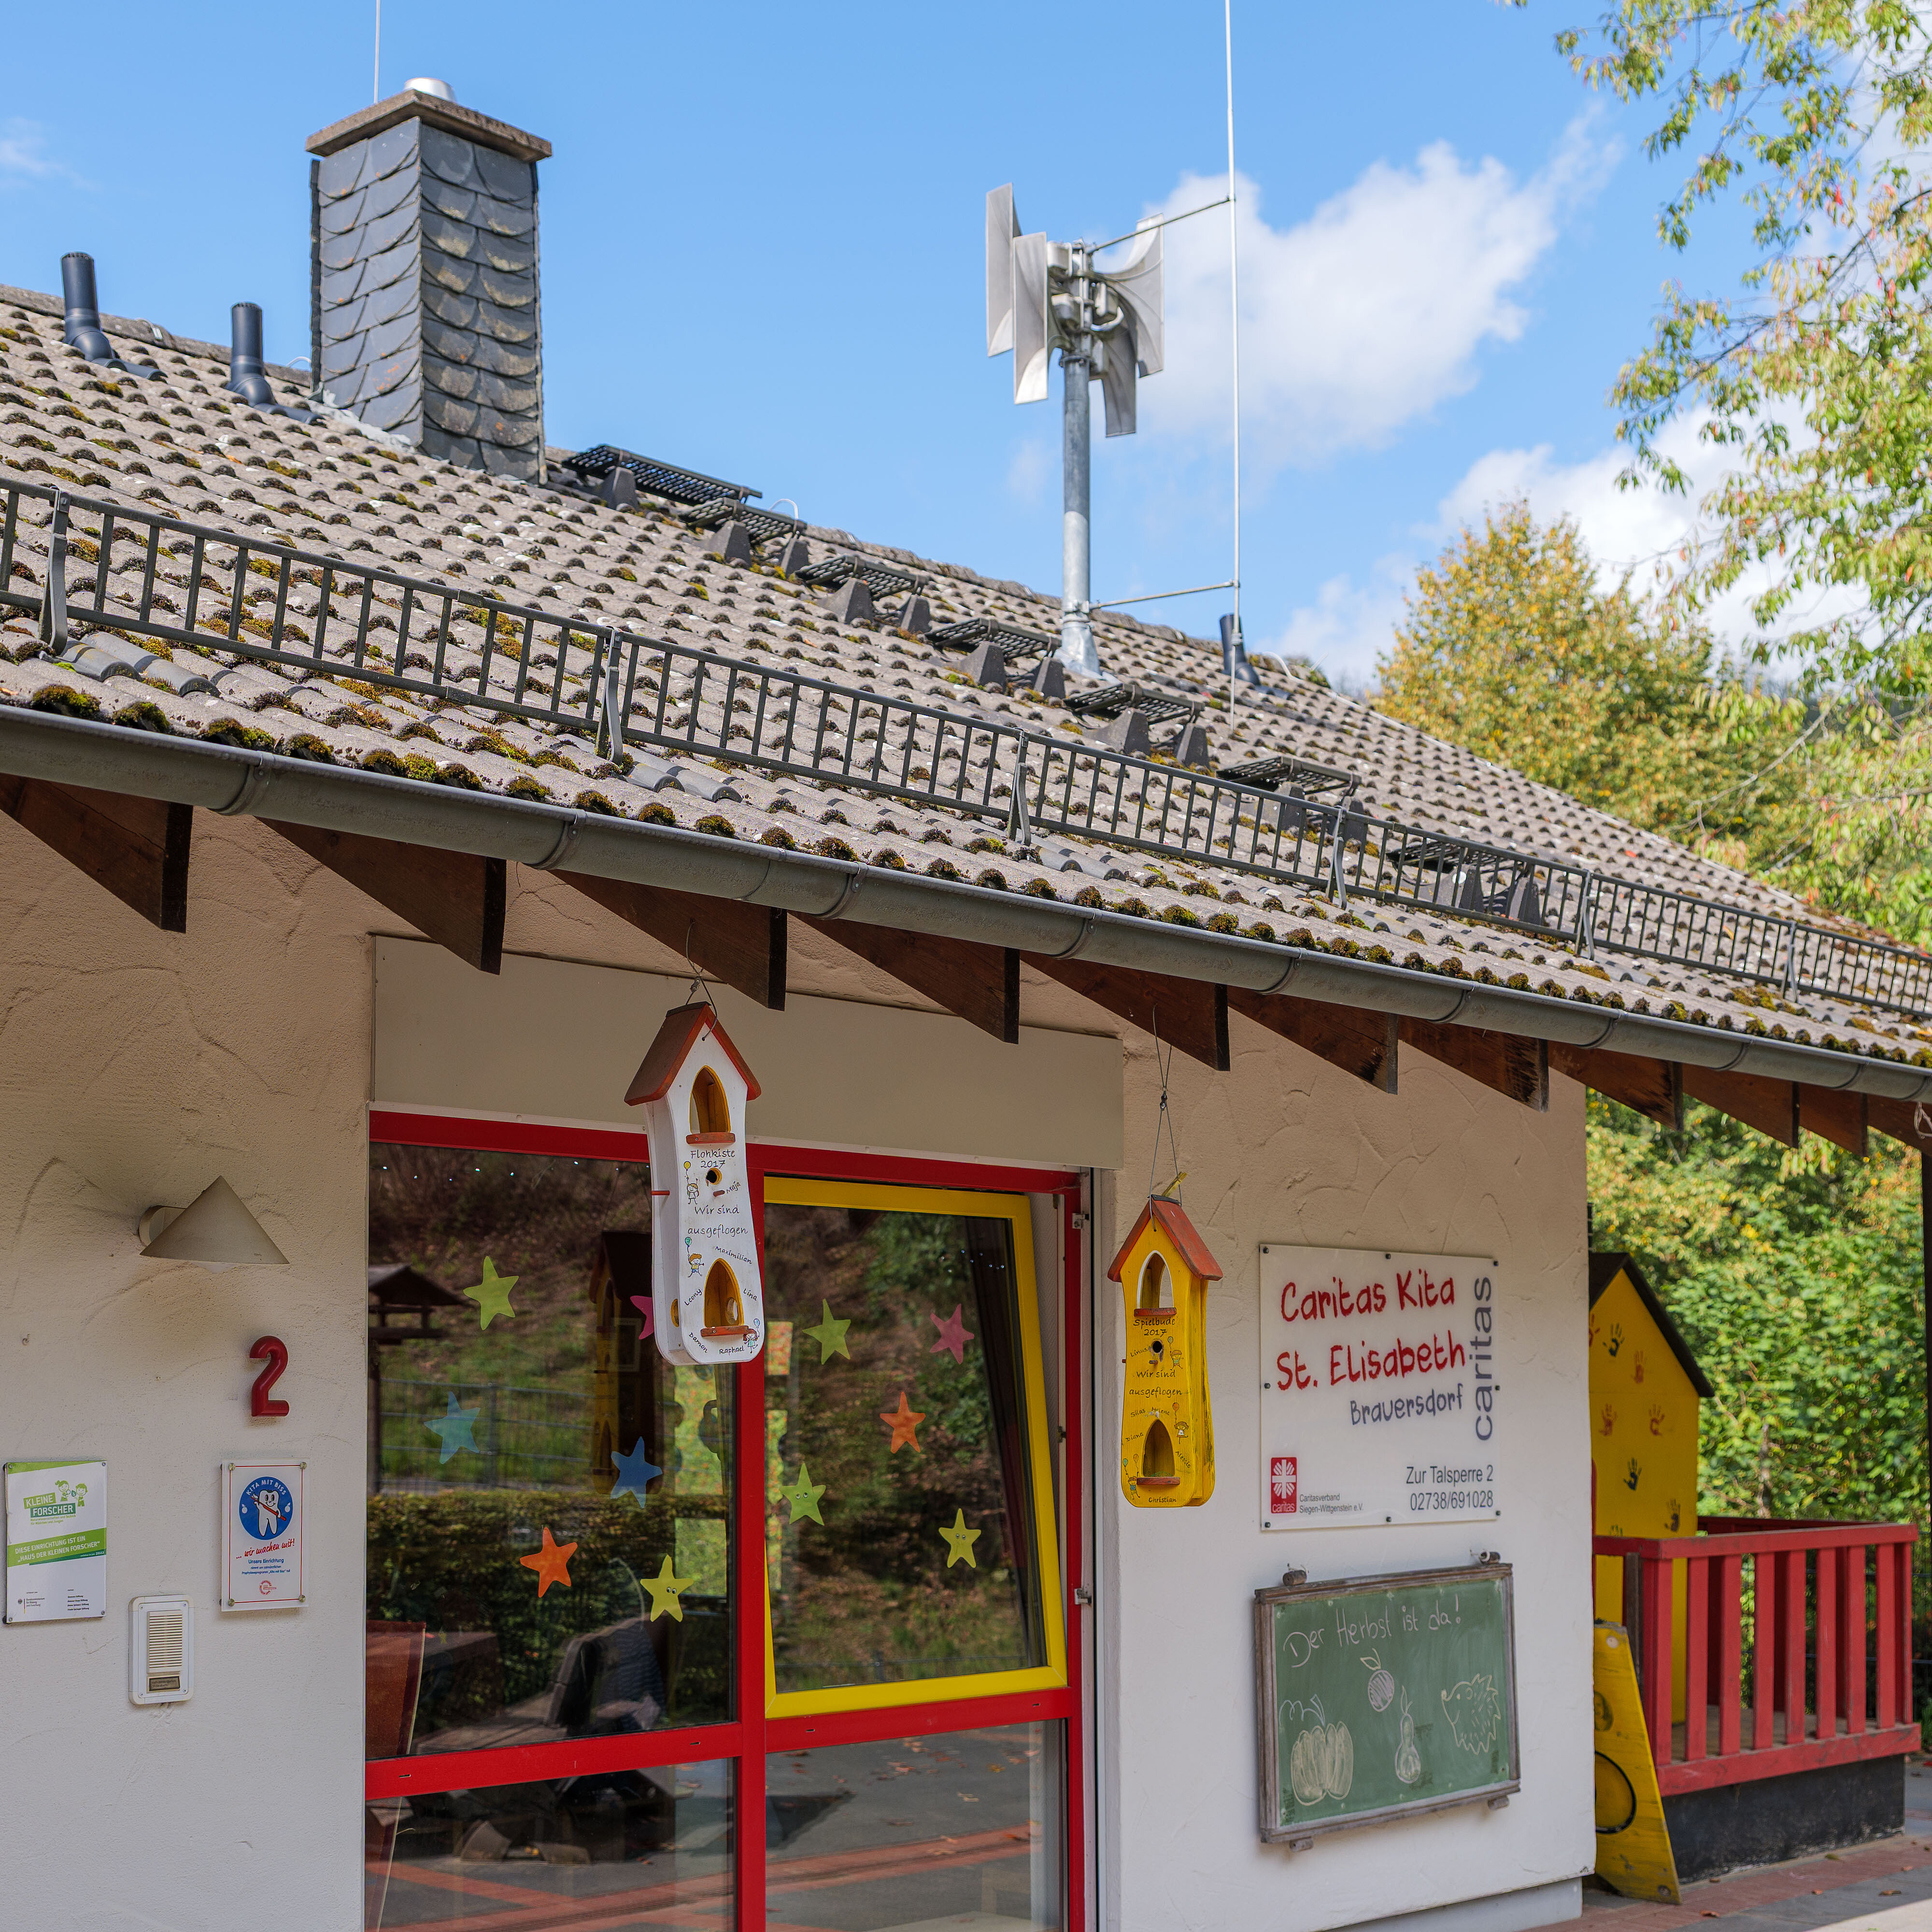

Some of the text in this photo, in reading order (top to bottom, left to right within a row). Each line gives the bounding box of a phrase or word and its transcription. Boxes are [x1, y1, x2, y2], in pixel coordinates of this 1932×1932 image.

[690, 1149, 736, 1159] Flohkiste
[700, 1160, 725, 1169] 2017
[726, 1181, 741, 1194] Maja
[695, 1204, 739, 1214] Wir sind
[688, 1224, 748, 1238] ausgeflogen
[715, 1246, 752, 1264] Maximilian
[684, 1289, 702, 1306] Leony
[743, 1288, 757, 1301] Lina
[1281, 1268, 1455, 1322] Caritas Kita
[1133, 1317, 1175, 1329] Spielbude
[689, 1332, 708, 1353] Damon
[719, 1345, 745, 1356] Raphael
[1130, 1347, 1148, 1357] Linus
[1277, 1330, 1465, 1391] St. Elisabeth
[1469, 1277, 1493, 1441] caritas
[249, 1335, 289, 1417] 2
[1136, 1369, 1176, 1378] Wir sind
[1129, 1387, 1182, 1398] ausgeflogen
[1350, 1383, 1463, 1425] Brauersdorf
[1131, 1409, 1146, 1417] Silas
[1125, 1432, 1144, 1442] Diana
[1406, 1464, 1493, 1487] Zur Talsperre 2
[246, 1482, 259, 1495] KITA
[274, 1482, 286, 1495] BISS
[26, 1494, 54, 1507] KLEINE
[1299, 1493, 1340, 1502] Caritasverband
[1410, 1490, 1493, 1510] 02738/691028
[33, 1505, 73, 1516] FORSCHER
[1272, 1501, 1295, 1513] caritas
[1299, 1504, 1352, 1515] Siegen-Wittgenstein
[15, 1546, 30, 1554] DIESE
[31, 1539, 67, 1550] EINRICHTUNG
[48, 1547, 70, 1556] KLEINEN
[244, 1547, 255, 1557] wir
[256, 1541, 280, 1554] machen
[282, 1538, 295, 1548] mit!
[1283, 1593, 1461, 1668] Der Herbst ist da!
